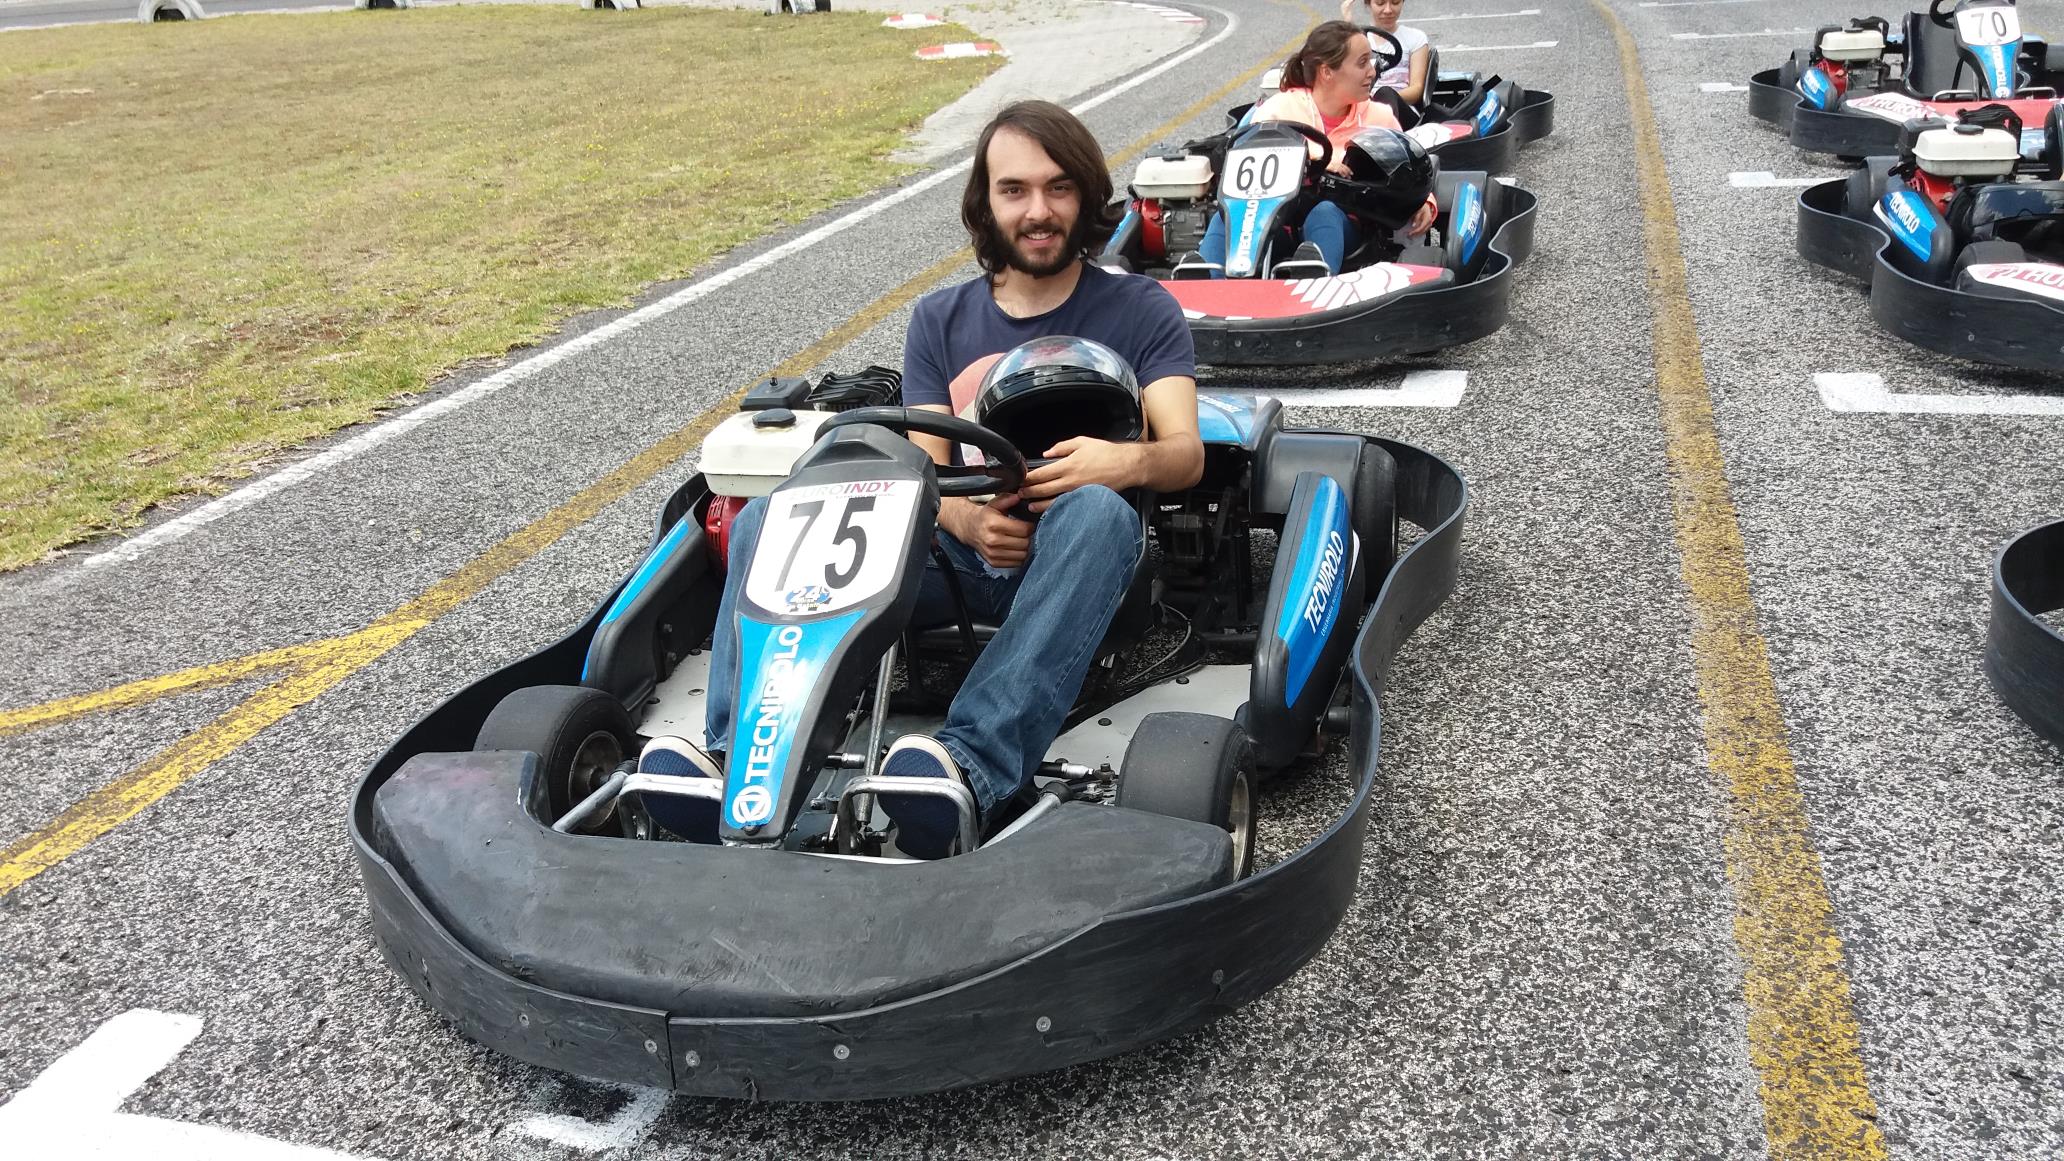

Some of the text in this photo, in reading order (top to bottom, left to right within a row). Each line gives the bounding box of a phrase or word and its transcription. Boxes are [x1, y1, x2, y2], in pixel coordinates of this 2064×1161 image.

[1971, 11, 2006, 38] 70
[1236, 153, 1279, 190] 60
[774, 496, 877, 592] 75
